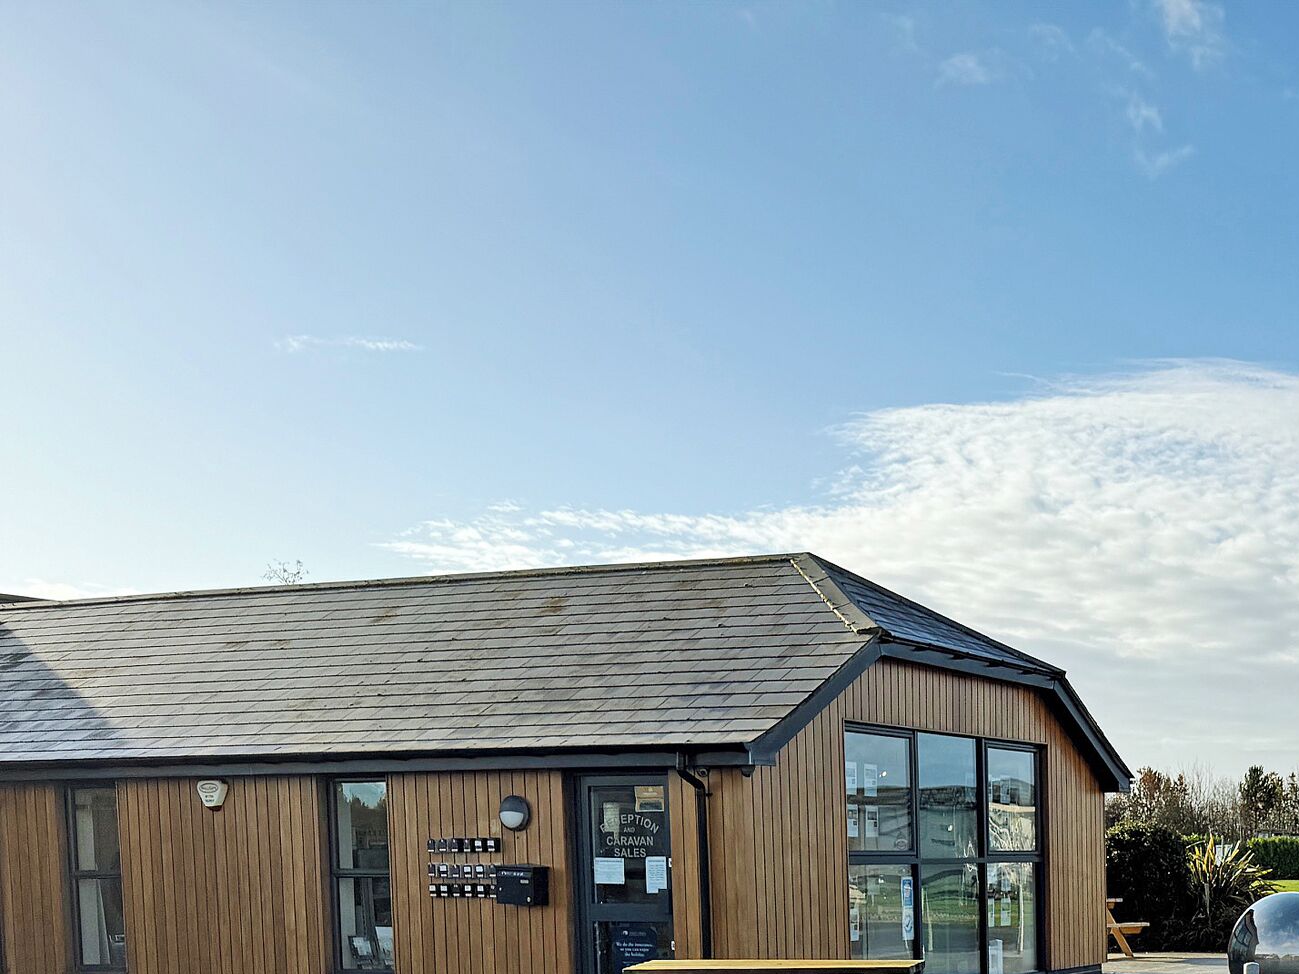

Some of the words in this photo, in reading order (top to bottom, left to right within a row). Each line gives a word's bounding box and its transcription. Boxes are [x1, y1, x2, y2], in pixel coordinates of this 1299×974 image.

[599, 814, 660, 834] REPTION
[606, 836, 654, 846] CARAVAN
[614, 848, 647, 858] SALES
